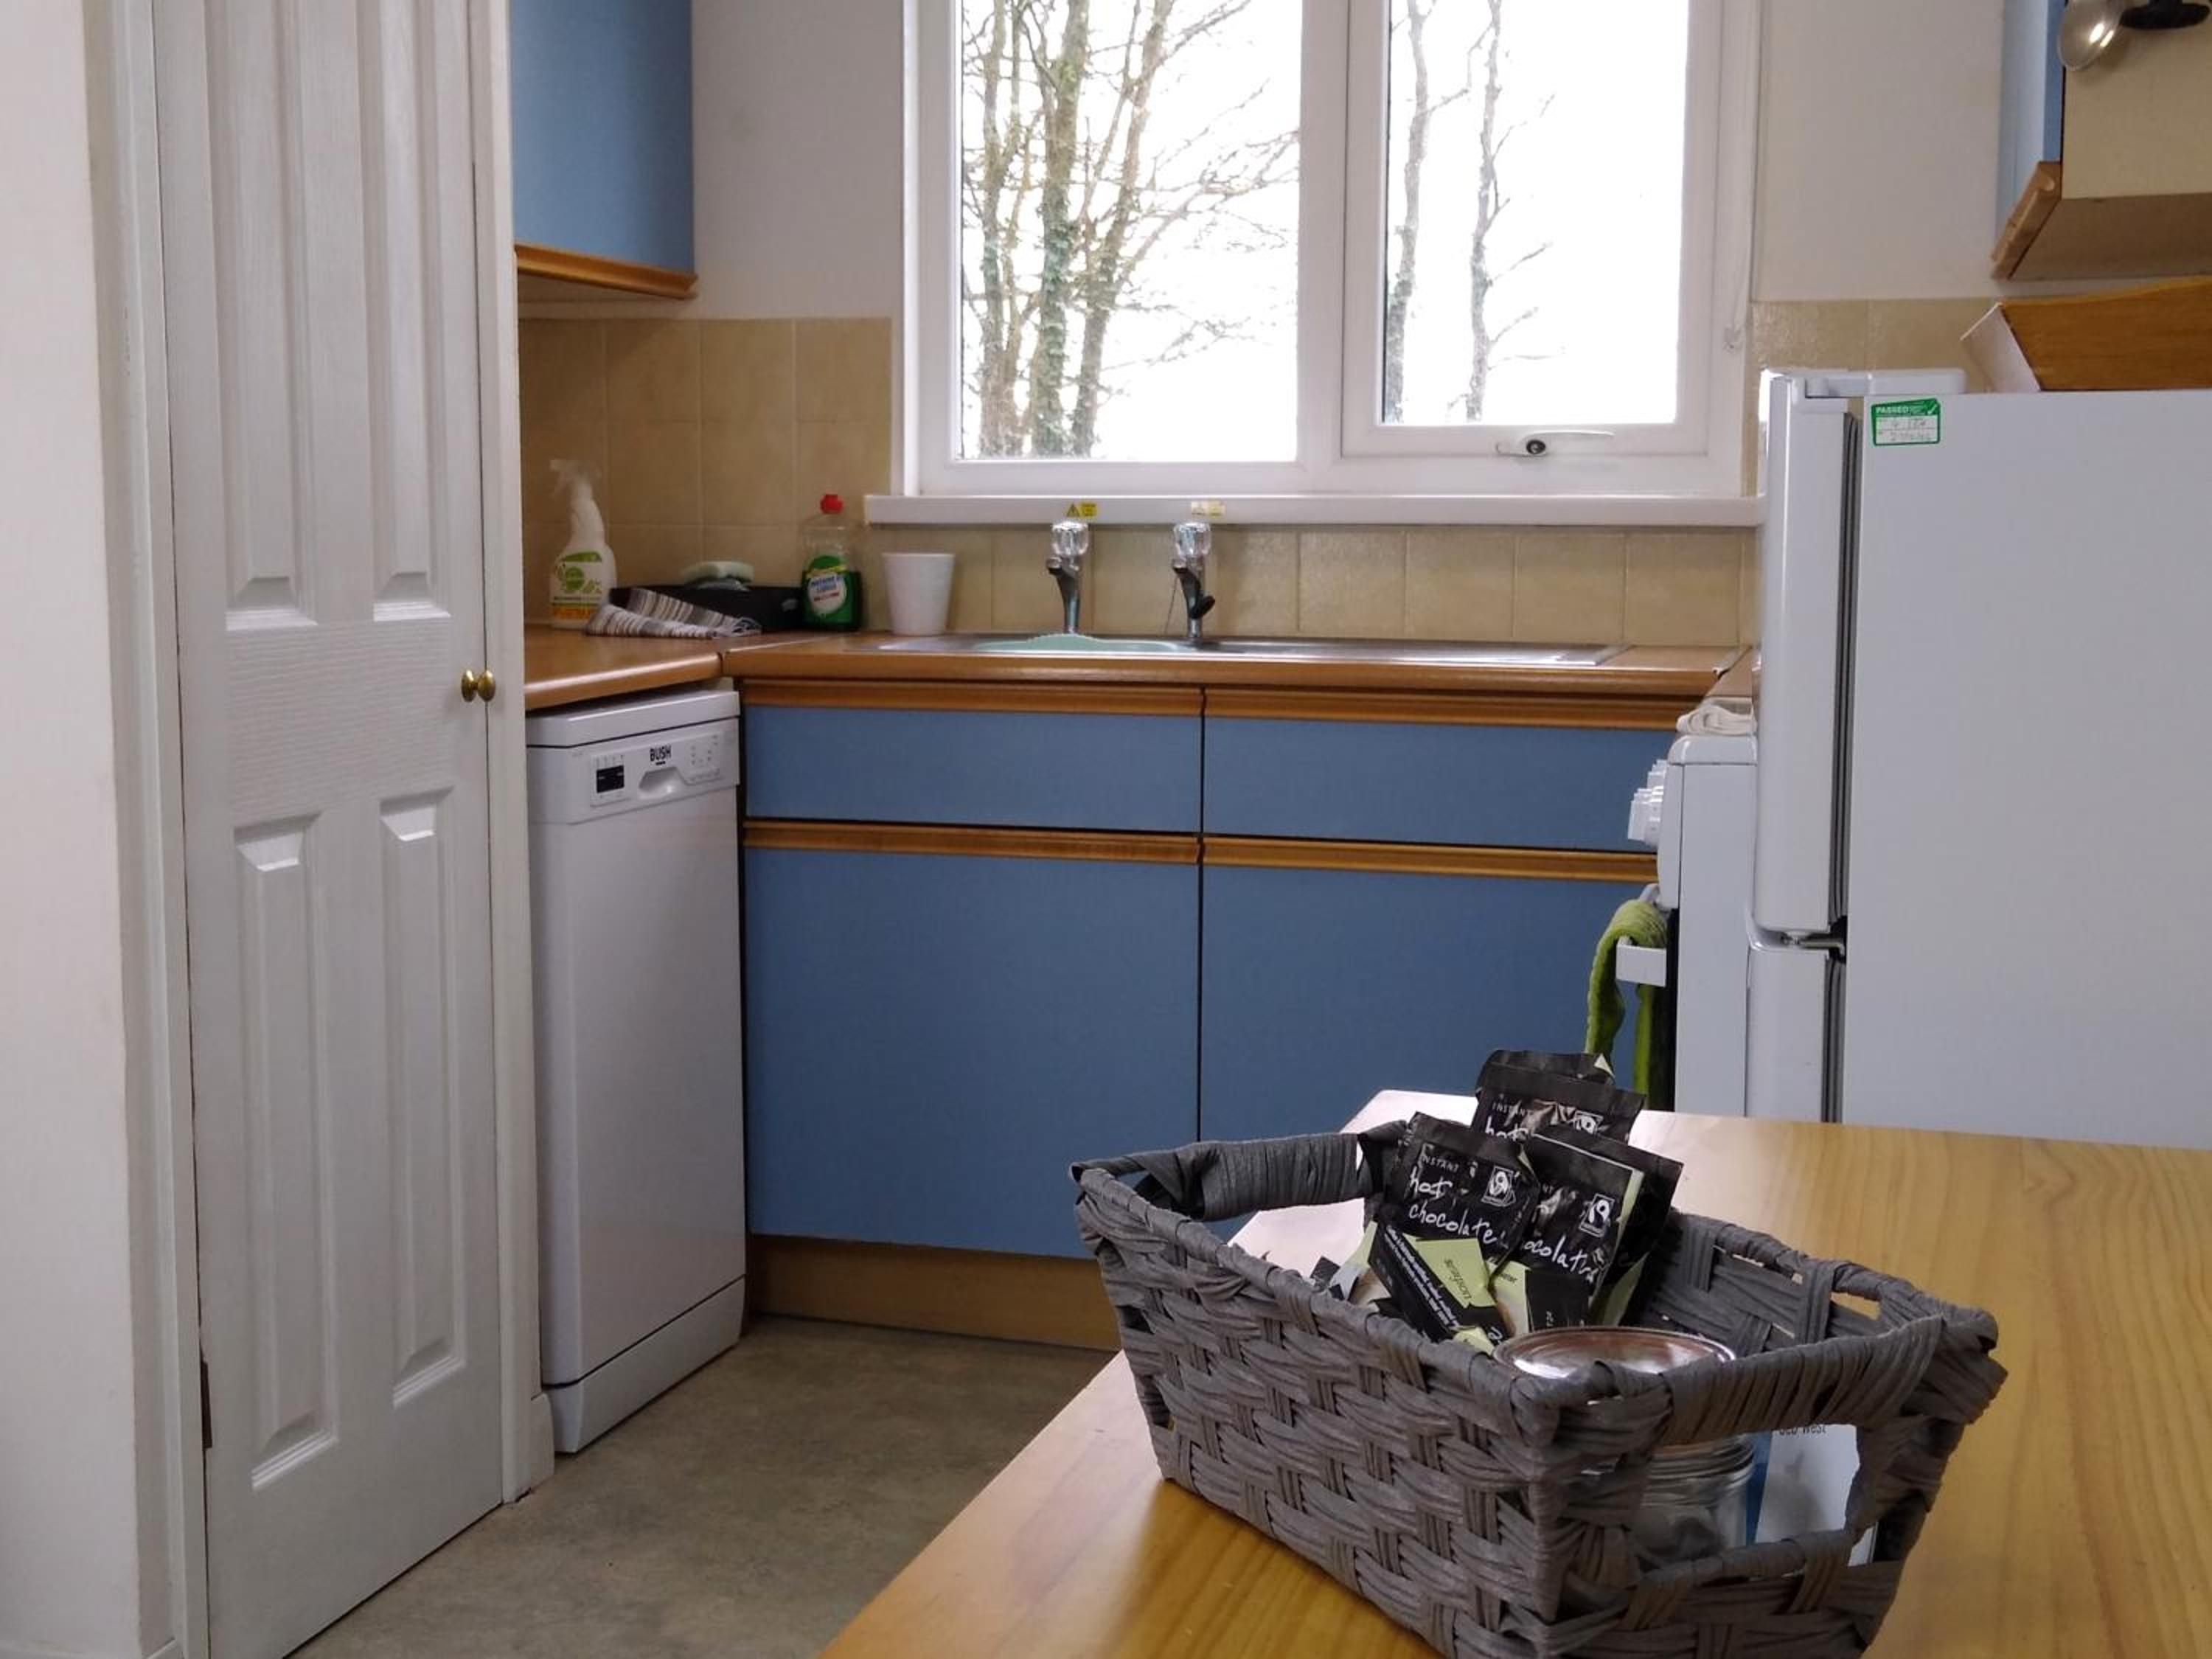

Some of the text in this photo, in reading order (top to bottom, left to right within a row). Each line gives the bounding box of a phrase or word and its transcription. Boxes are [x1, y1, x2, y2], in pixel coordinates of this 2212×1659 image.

[650, 745, 672, 762] BUSH
[1409, 1166, 1453, 1200] hot
[1408, 1199, 1498, 1244] chocolate
